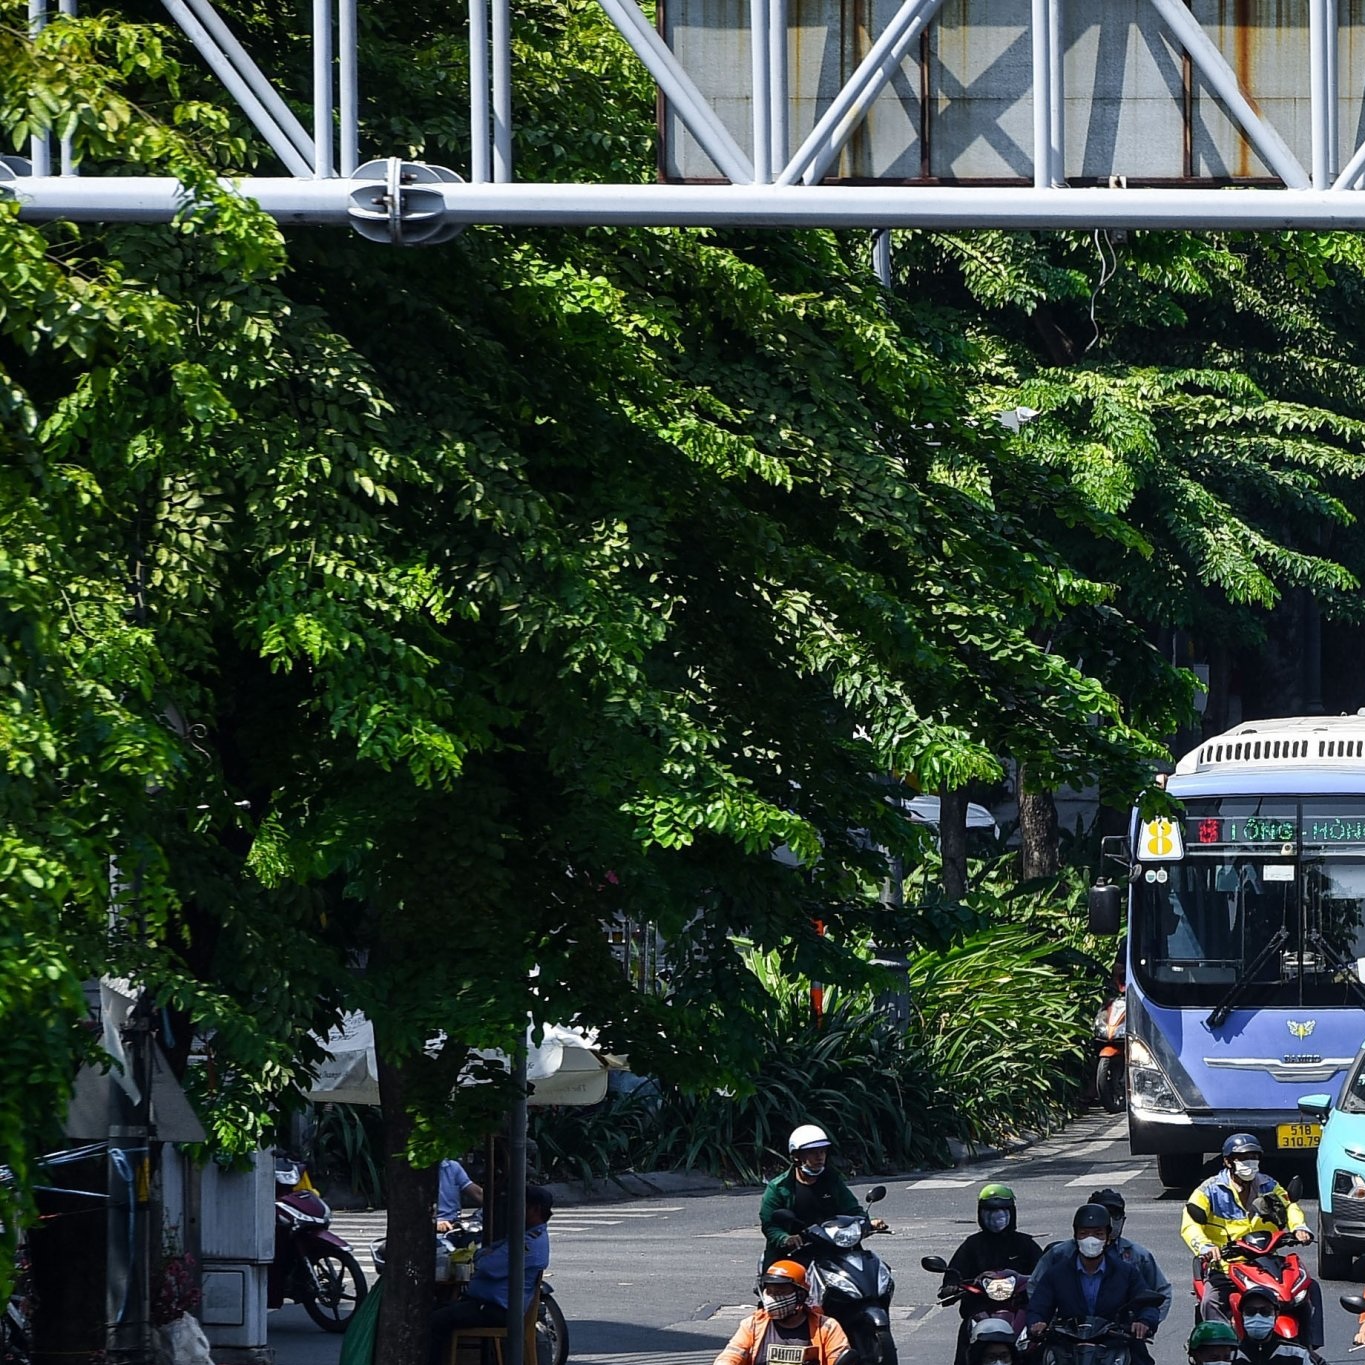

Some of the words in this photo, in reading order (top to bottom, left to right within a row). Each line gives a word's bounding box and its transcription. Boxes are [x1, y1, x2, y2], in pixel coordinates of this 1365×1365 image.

[1147, 820, 1173, 855] 8
[1291, 1125, 1311, 1136] 51B
[1282, 1136, 1320, 1147] 310.79
[770, 1347, 801, 1361] PUMA
